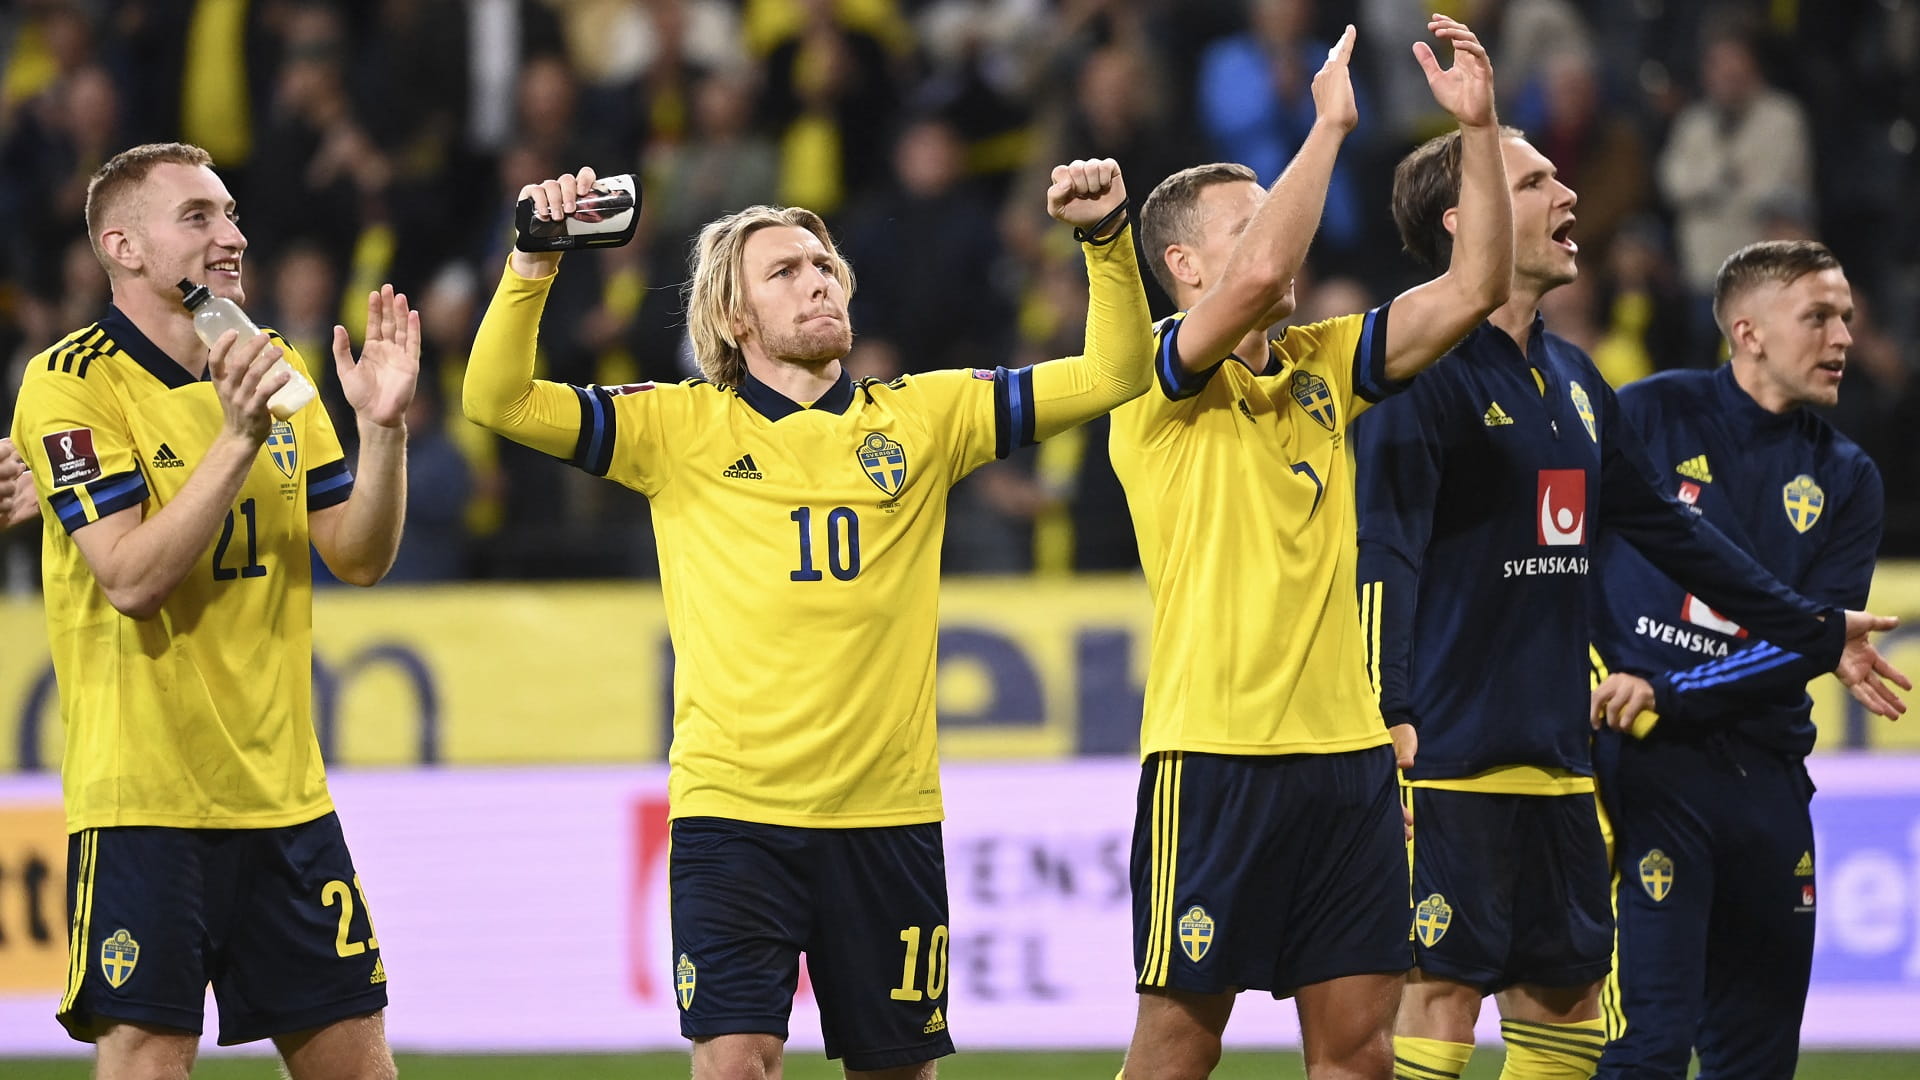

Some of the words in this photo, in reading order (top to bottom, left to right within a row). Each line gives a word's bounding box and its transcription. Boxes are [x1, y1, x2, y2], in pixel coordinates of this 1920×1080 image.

[152, 459, 185, 469] adidas
[723, 469, 763, 480] adidas
[865, 450, 896, 459] SVERIGE
[212, 498, 267, 581] 21
[790, 506, 861, 582] 10
[1635, 616, 1729, 658] SVENSKA
[890, 924, 949, 1001] 10
